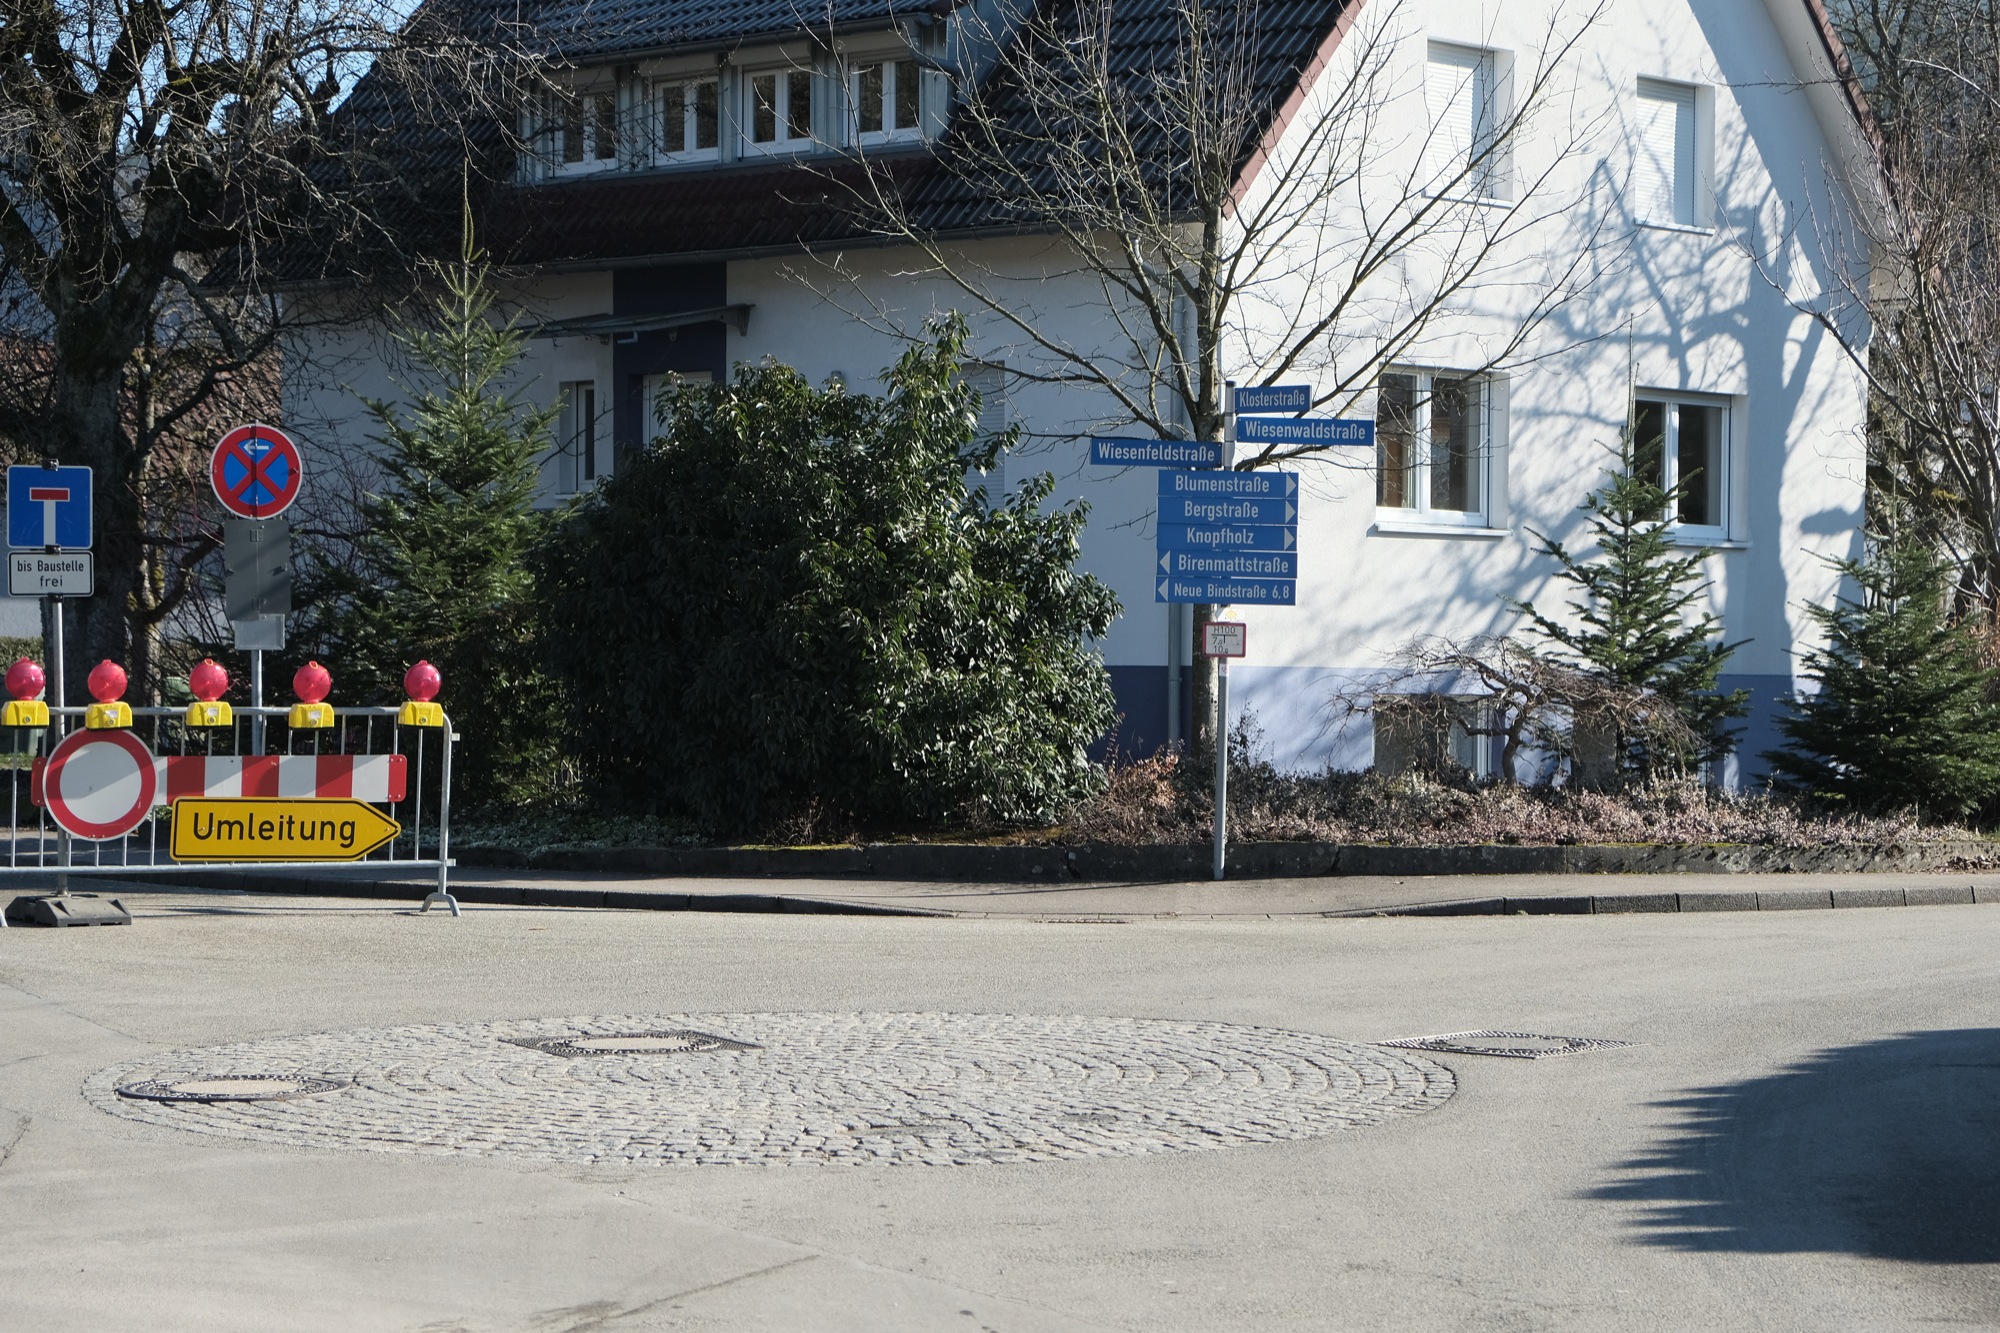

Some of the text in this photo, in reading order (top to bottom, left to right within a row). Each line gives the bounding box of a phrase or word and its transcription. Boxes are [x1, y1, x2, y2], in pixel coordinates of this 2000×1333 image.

[1239, 390, 1305, 408] Klosterstraße
[1245, 420, 1366, 440] Wiesenwaldstraße
[1098, 443, 1215, 462] Wiesenfeldstraße
[1176, 476, 1269, 493] Blumenstraße
[1185, 501, 1259, 520] Bergstraße
[1187, 528, 1254, 547] Knopfholz
[17, 560, 84, 572] bis Baustelle
[1179, 555, 1289, 573] Birenmattstraße
[40, 576, 63, 587] frei
[1174, 584, 1202, 597] Neue
[1208, 584, 1266, 598] Bindstraße
[194, 812, 356, 848] Umleitung
